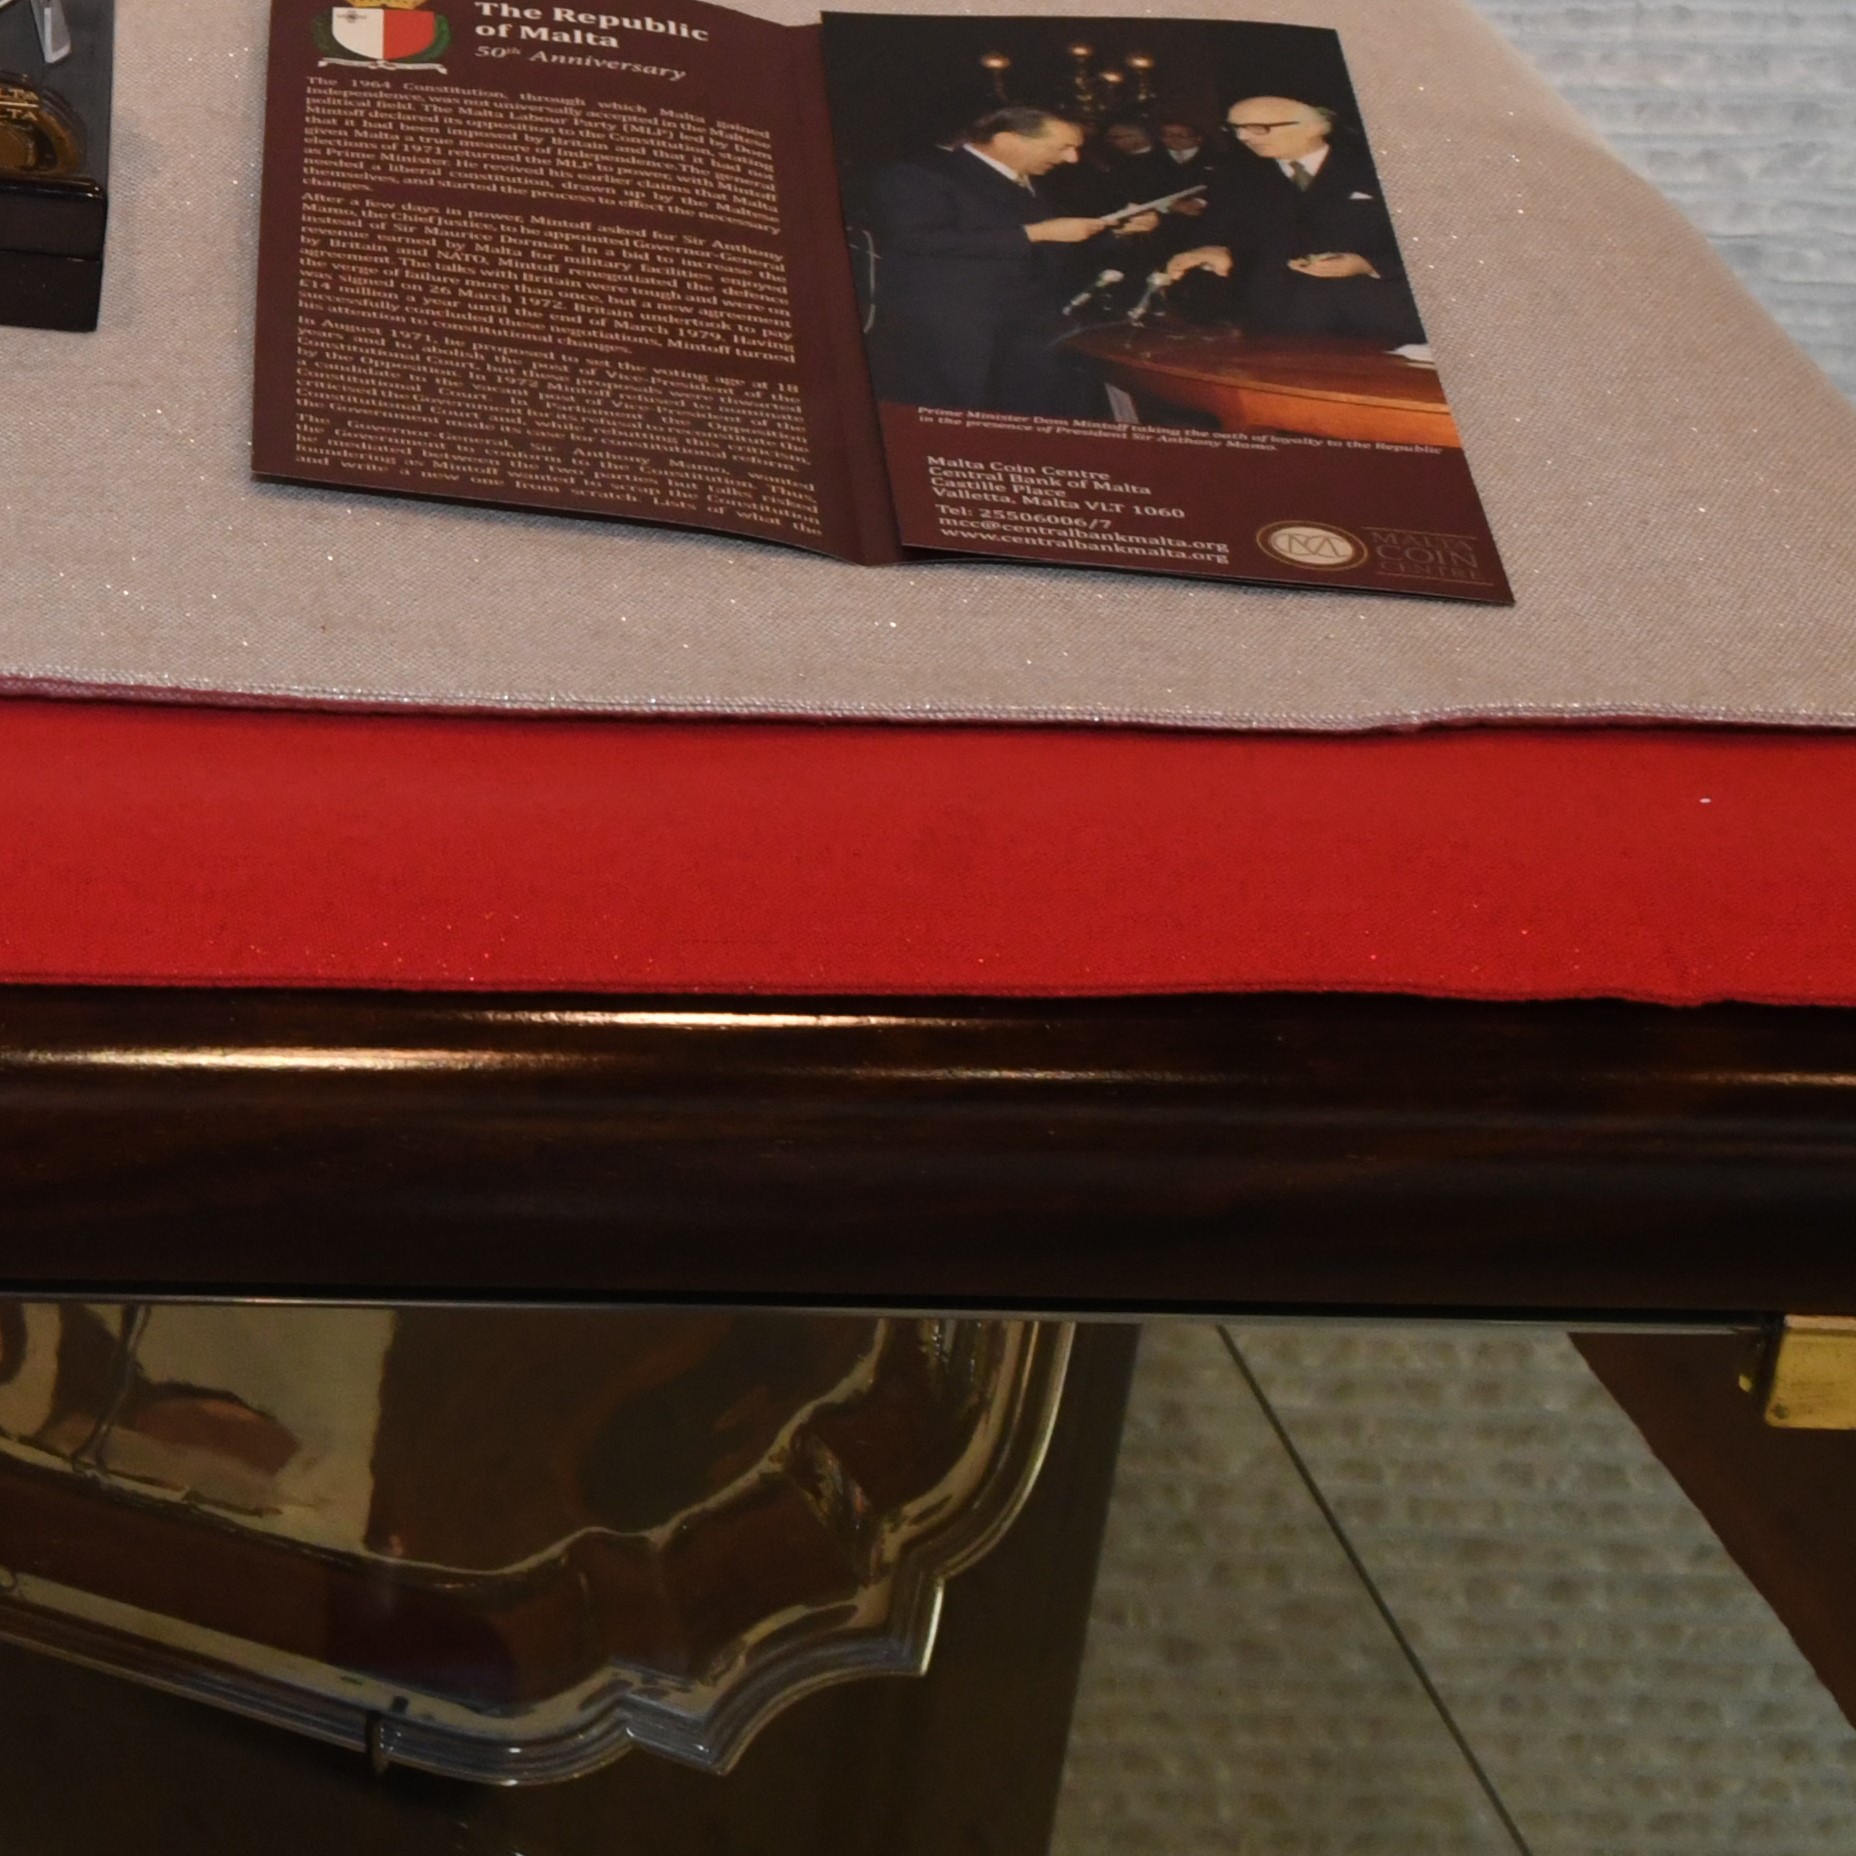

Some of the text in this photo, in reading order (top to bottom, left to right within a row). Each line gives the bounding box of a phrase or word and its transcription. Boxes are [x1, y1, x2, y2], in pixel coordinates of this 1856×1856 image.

[474, 2, 709, 42] The Republic
[475, 24, 620, 48] of Malta
[530, 50, 686, 81] Anniversary
[918, 406, 1443, 454] Prime Minister Dom Mintoff taking the oath of loyalty to the Republic
[919, 414, 934, 423] in
[938, 416, 962, 426] the
[966, 420, 1033, 432] presence
[1036, 424, 1054, 434] of
[1056, 426, 1128, 440] President
[1132, 432, 1153, 441] Sir
[1155, 434, 1221, 448] Anthony
[927, 455, 1111, 480] Malta Coin Centre
[929, 466, 1152, 495] Central Bank of Malta
[931, 477, 1066, 498] Castille Place
[935, 504, 1112, 530] Tel: 25506006/7
[1022, 495, 1080, 510] Malta
[1132, 504, 1185, 519] 1060
[938, 517, 1230, 553] mcc@centralbankmalta.org
[940, 528, 1228, 564] www.centralbankmalta.org
[1376, 544, 1478, 568] COIN
